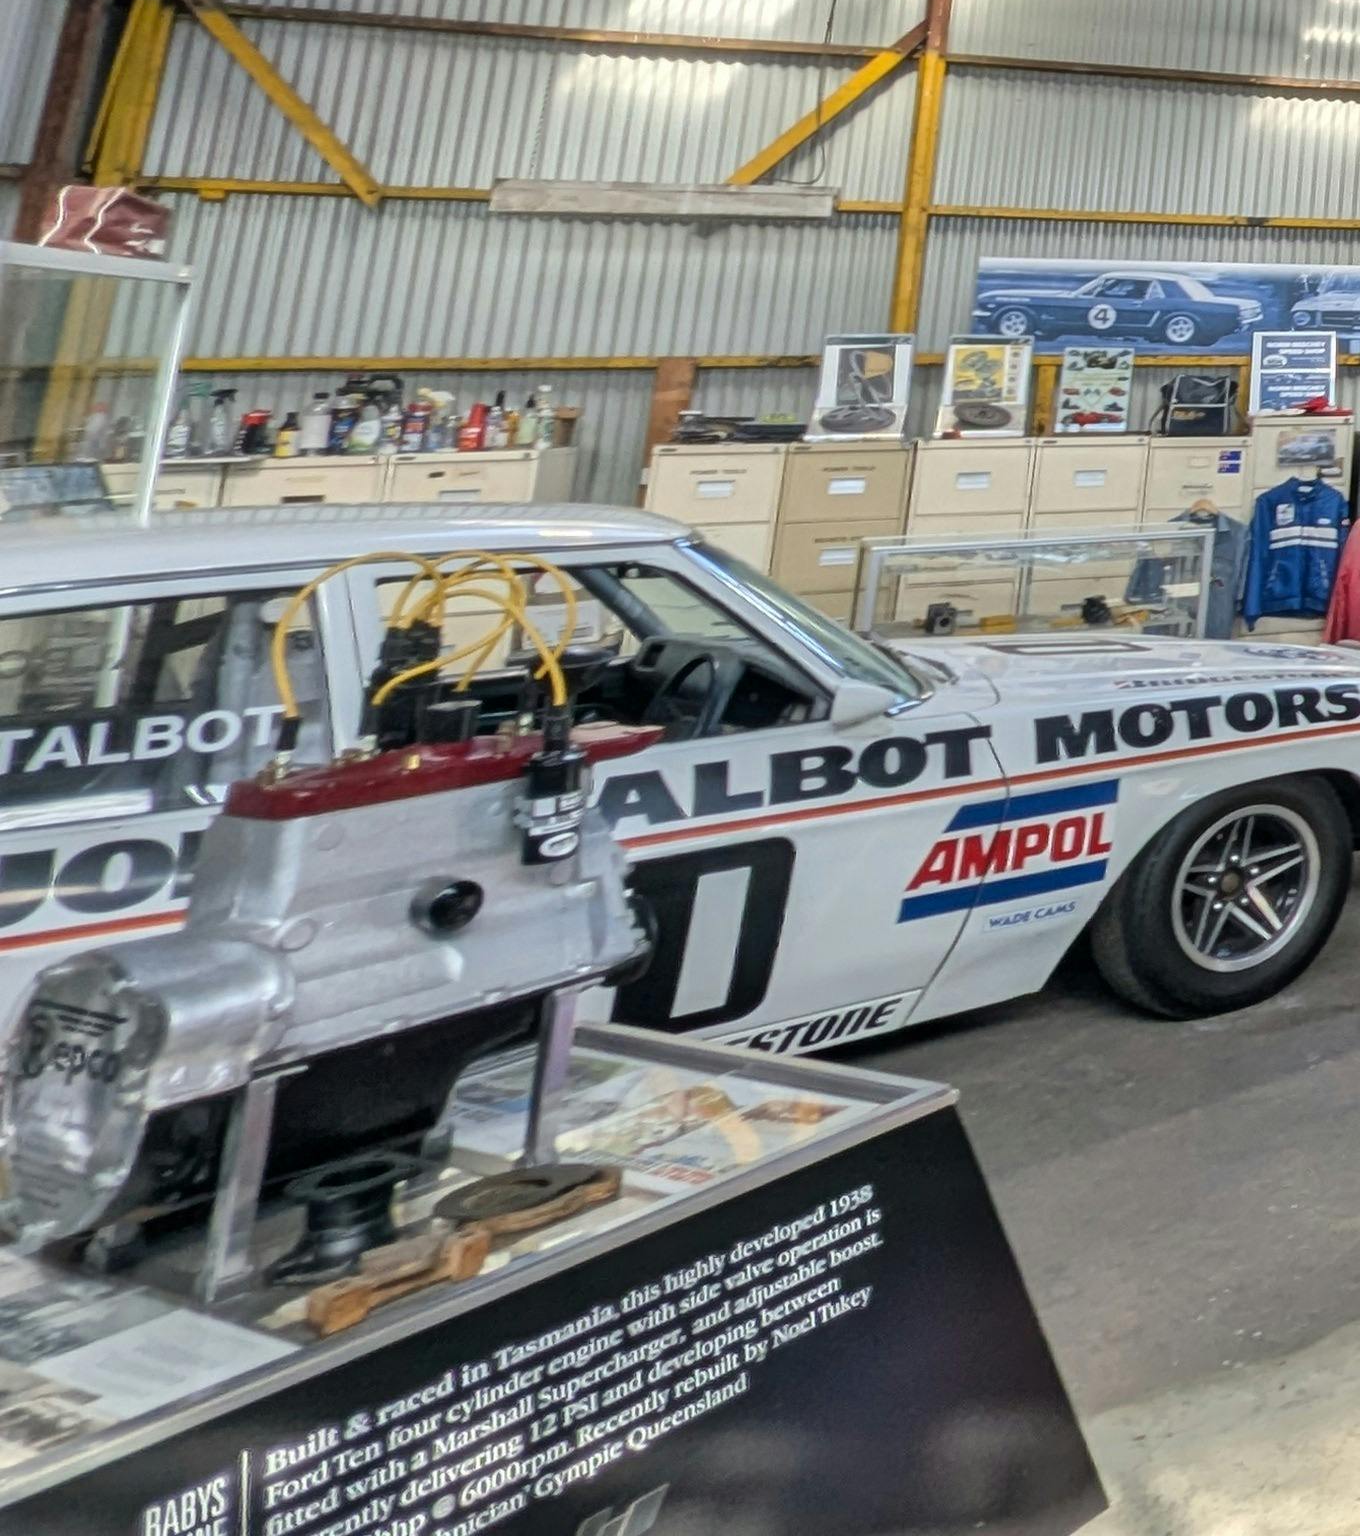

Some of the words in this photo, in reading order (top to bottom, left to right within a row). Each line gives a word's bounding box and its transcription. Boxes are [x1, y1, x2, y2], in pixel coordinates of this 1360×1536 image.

[1093, 306, 1110, 325] 4
[0, 704, 290, 776] TALBOT
[597, 725, 992, 831] ALBOT
[904, 811, 1113, 892] AMPOL
[989, 911, 1031, 928] WADE
[1034, 901, 1077, 920] CAMS
[724, 997, 903, 1055] STONE
[263, 1426, 339, 1478] Built
[344, 1412, 372, 1440] &
[374, 1371, 455, 1428] raced
[461, 1362, 489, 1387] in
[620, 1284, 660, 1313] this
[662, 1253, 726, 1295] highly
[729, 1206, 826, 1263] developed
[830, 1184, 875, 1218] 1938
[263, 1460, 331, 1509] Ford
[332, 1440, 383, 1476] Ten
[386, 1414, 441, 1452] four
[445, 1365, 545, 1423] cylinder
[547, 1329, 625, 1376] engine
[626, 1303, 677, 1337] with
[679, 1282, 721, 1315] side
[724, 1256, 774, 1290] valve
[777, 1216, 862, 1266] operation
[866, 1208, 882, 1226] is
[263, 1486, 340, 1536] fitted
[345, 1460, 406, 1501] with
[410, 1450, 429, 1472] a
[431, 1393, 535, 1461] Marshall
[537, 1327, 687, 1409] Supercharger,
[691, 1302, 730, 1336] and
[733, 1258, 828, 1314] adjustable
[828, 1231, 884, 1268] boost.
[399, 1435, 524, 1507] delivering
[529, 1413, 558, 1443] 12
[561, 1394, 599, 1427] PSI
[601, 1374, 643, 1408] and
[647, 1318, 759, 1384] developing
[761, 1277, 841, 1328] between
[459, 1440, 575, 1508] 6000rpm.
[575, 1387, 670, 1448] Recently
[674, 1351, 740, 1399] rebuilt
[744, 1340, 769, 1364] by
[771, 1311, 816, 1349] Noel
[818, 1285, 874, 1324] Tukey
[626, 1371, 749, 1451] Queensland
